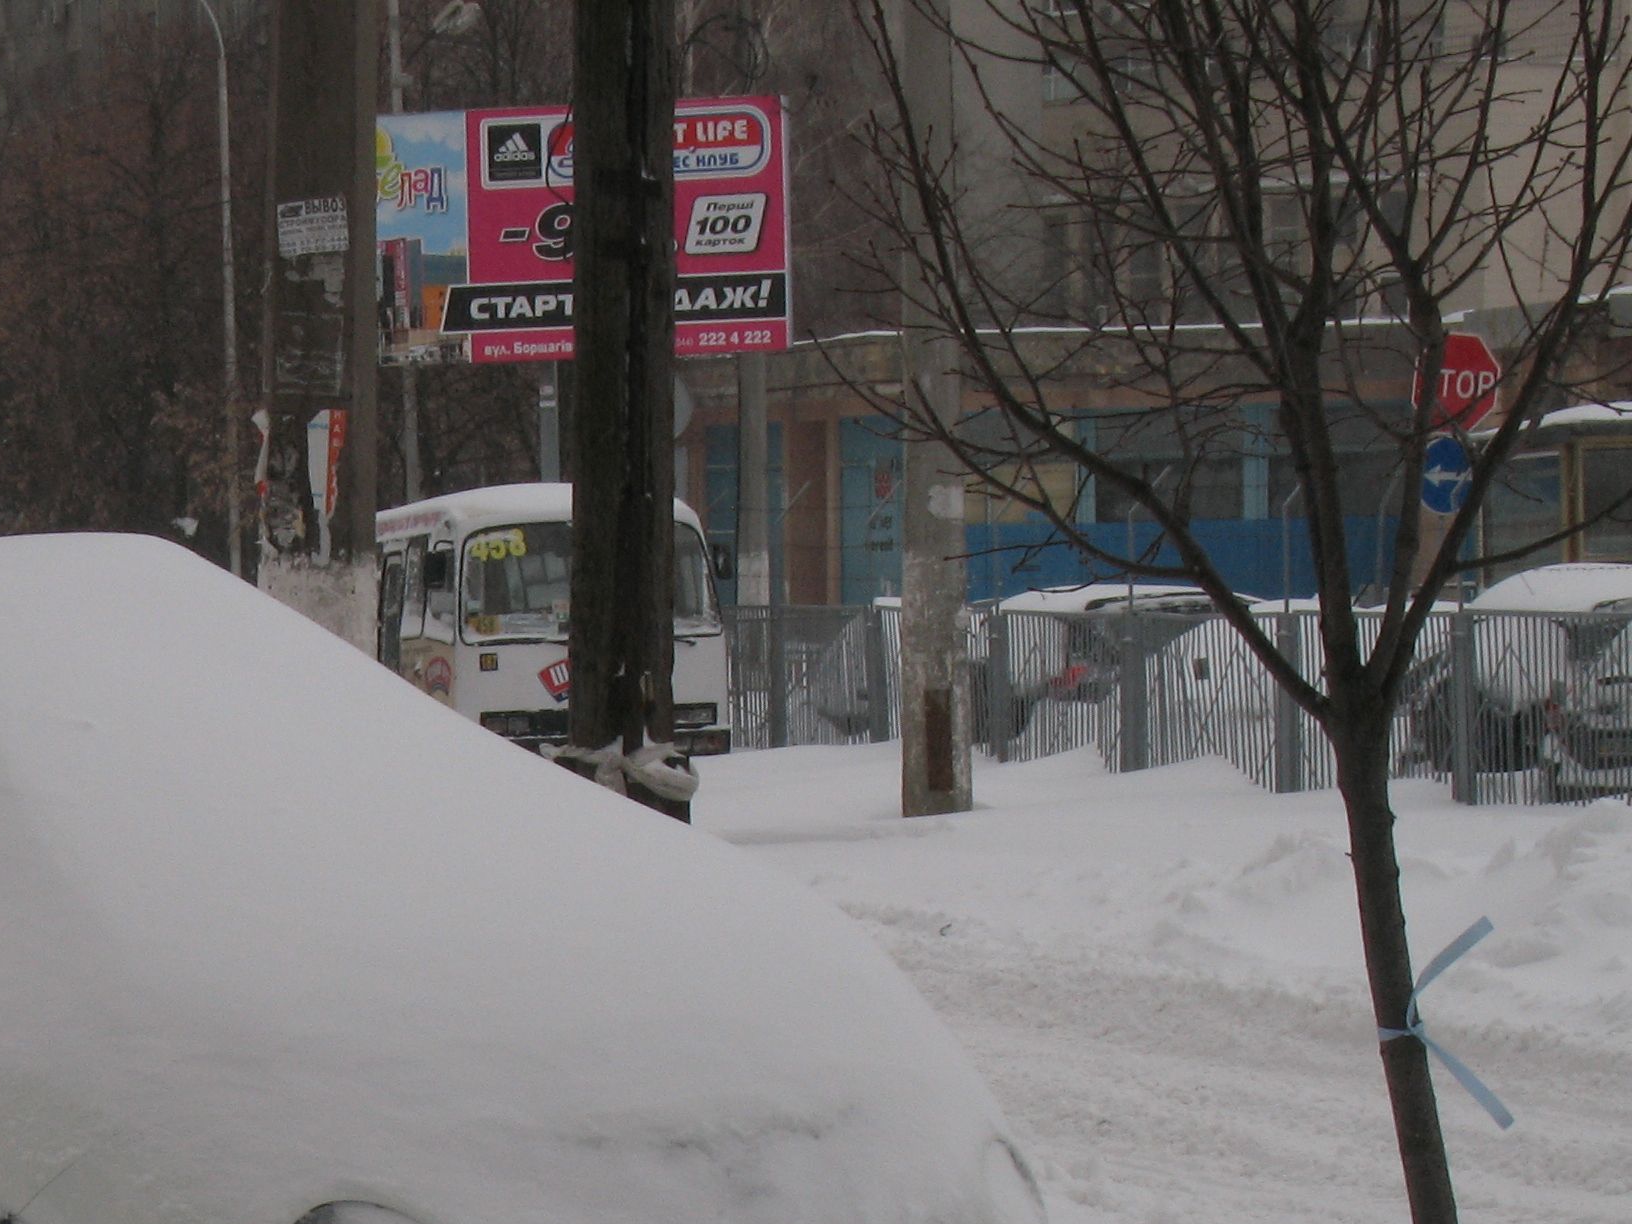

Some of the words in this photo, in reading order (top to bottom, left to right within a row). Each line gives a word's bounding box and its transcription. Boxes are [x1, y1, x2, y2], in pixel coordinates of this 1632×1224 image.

[494, 150, 535, 162] adidas
[696, 119, 748, 142] LIFE
[706, 200, 754, 213] Перші
[695, 214, 753, 235] 100
[695, 236, 745, 248] карток
[674, 279, 772, 311] ДАЖ!
[484, 345, 511, 358] вул.
[699, 331, 726, 346] 222
[730, 331, 739, 344] 4
[744, 329, 772, 345] 222
[1438, 368, 1496, 399] TOP
